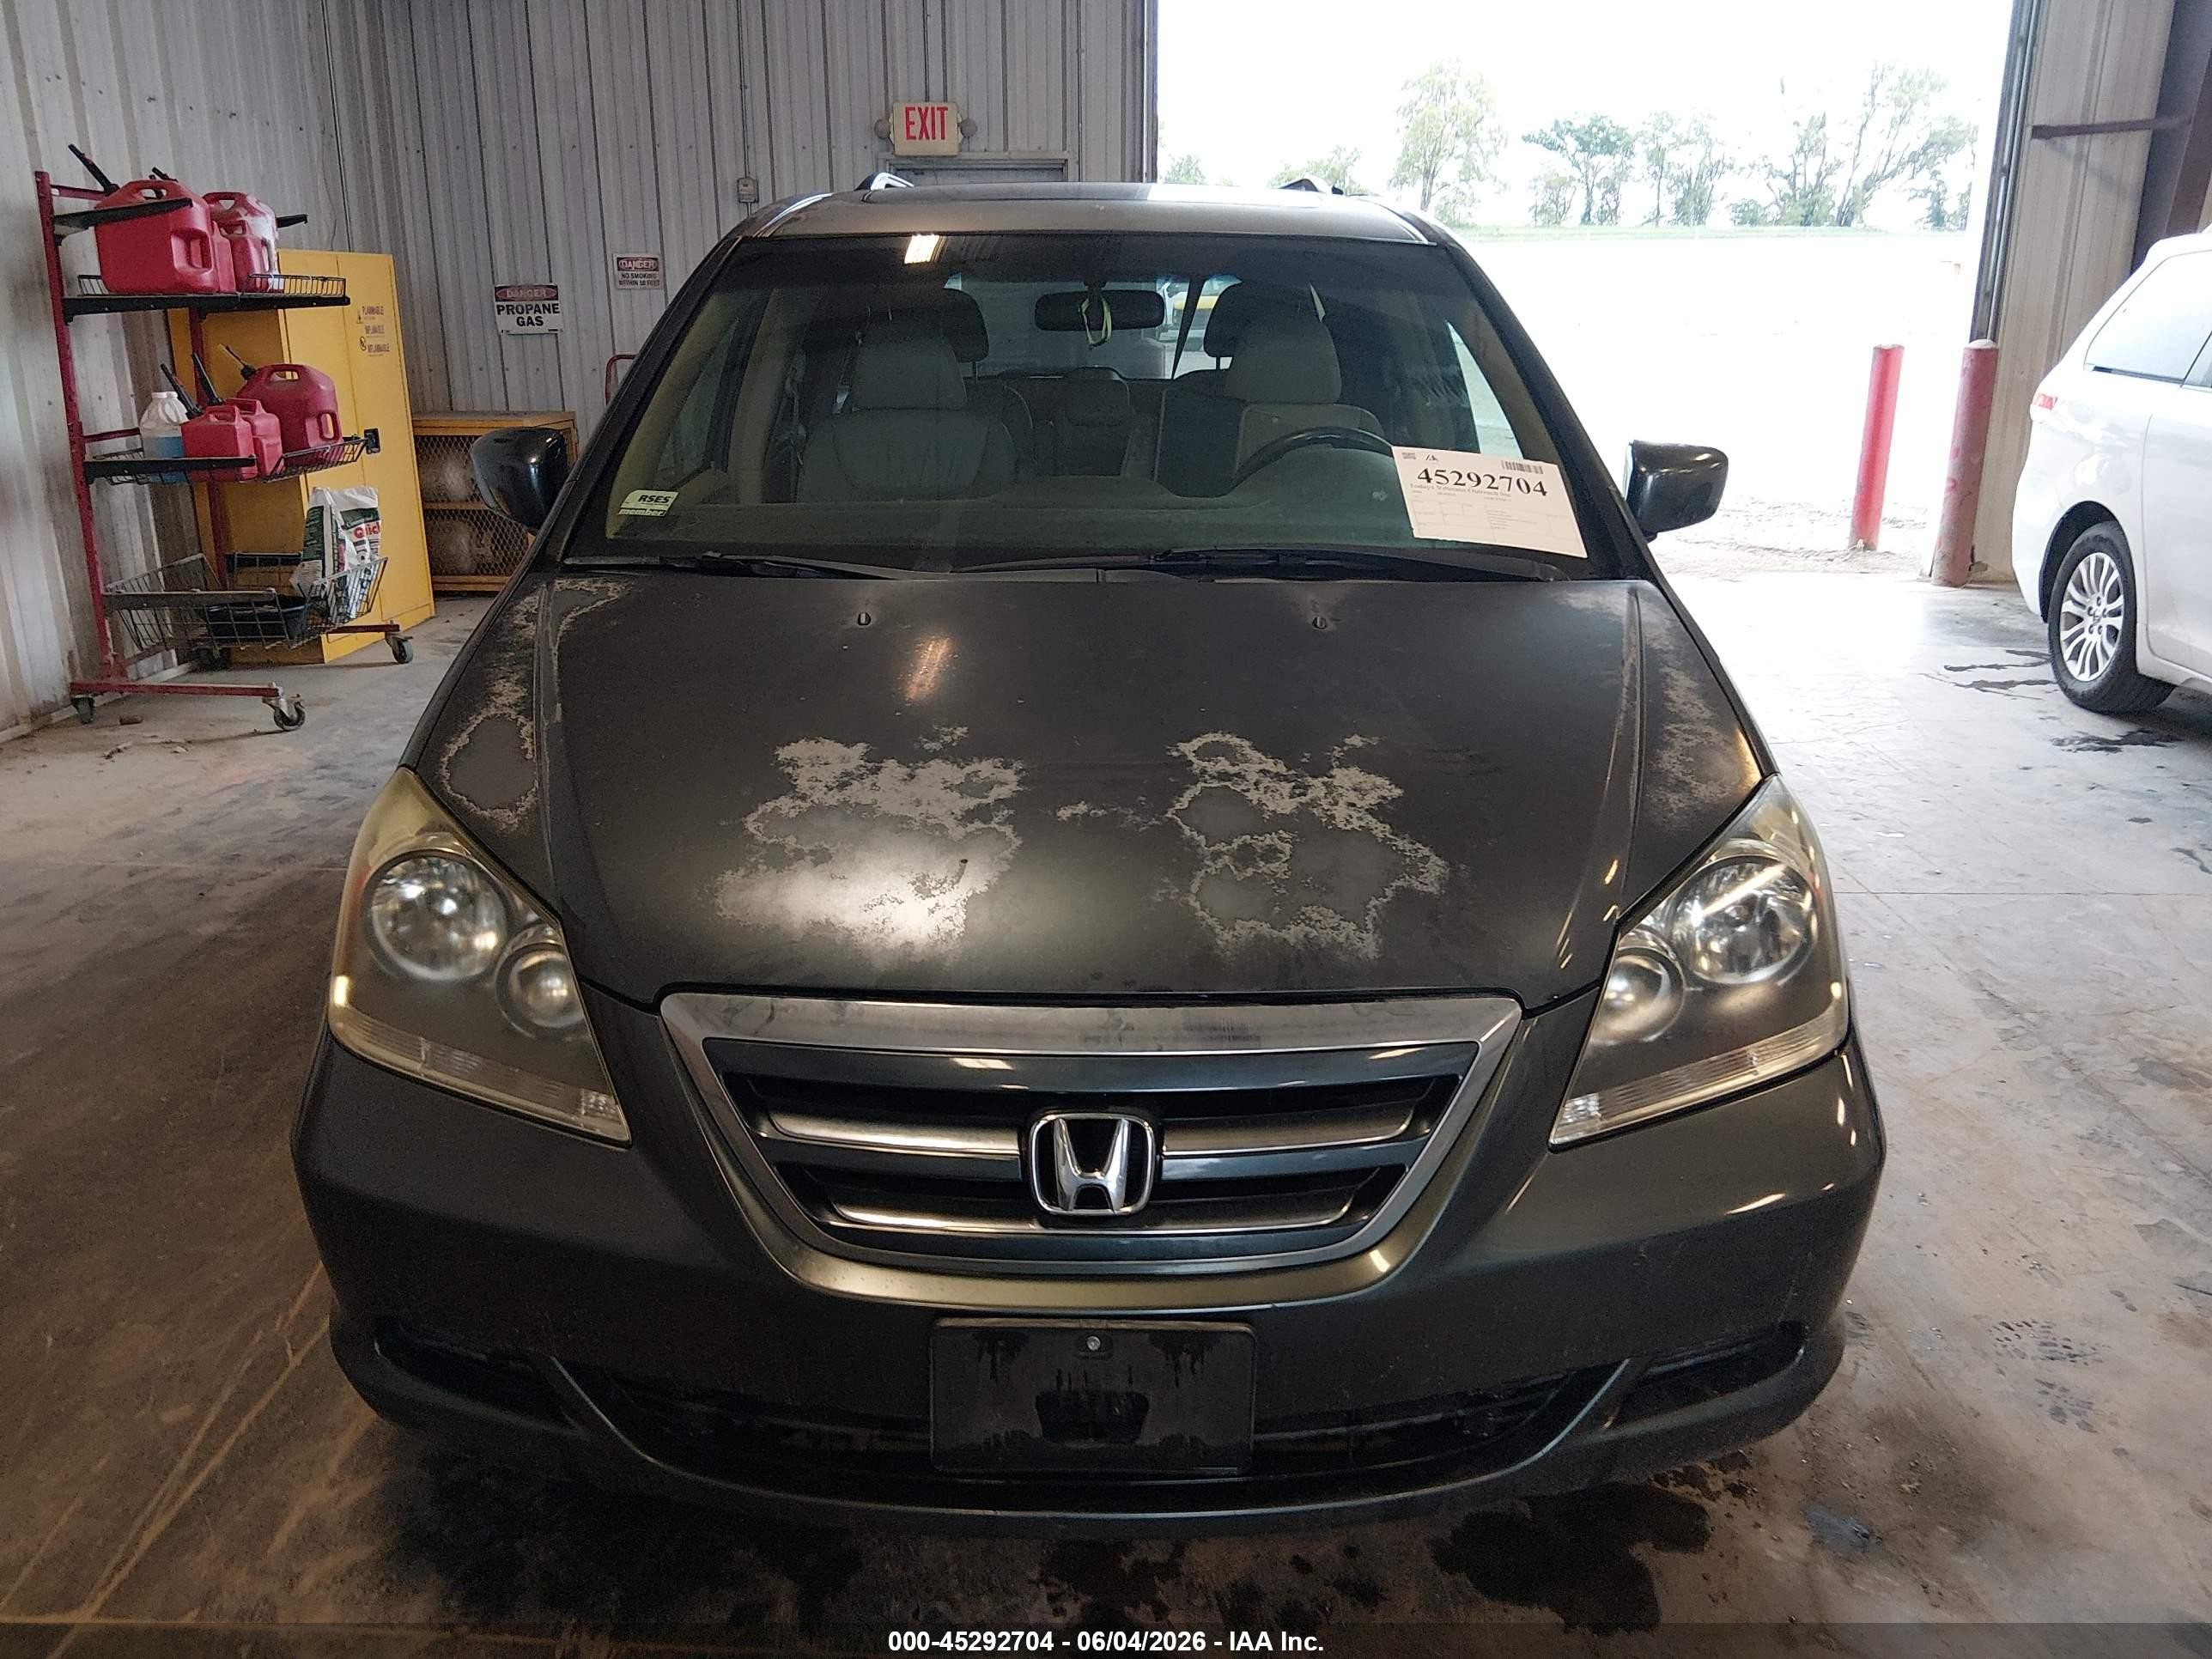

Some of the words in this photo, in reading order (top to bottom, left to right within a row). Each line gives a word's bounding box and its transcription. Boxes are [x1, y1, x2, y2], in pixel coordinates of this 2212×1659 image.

[904, 106, 948, 141] EXIT
[622, 260, 654, 269] DANGER
[506, 289, 547, 298] DANGER
[496, 303, 561, 315] PROPANE
[516, 316, 544, 326] GAS
[1417, 468, 1547, 496] 45292704
[638, 495, 671, 503] RSES
